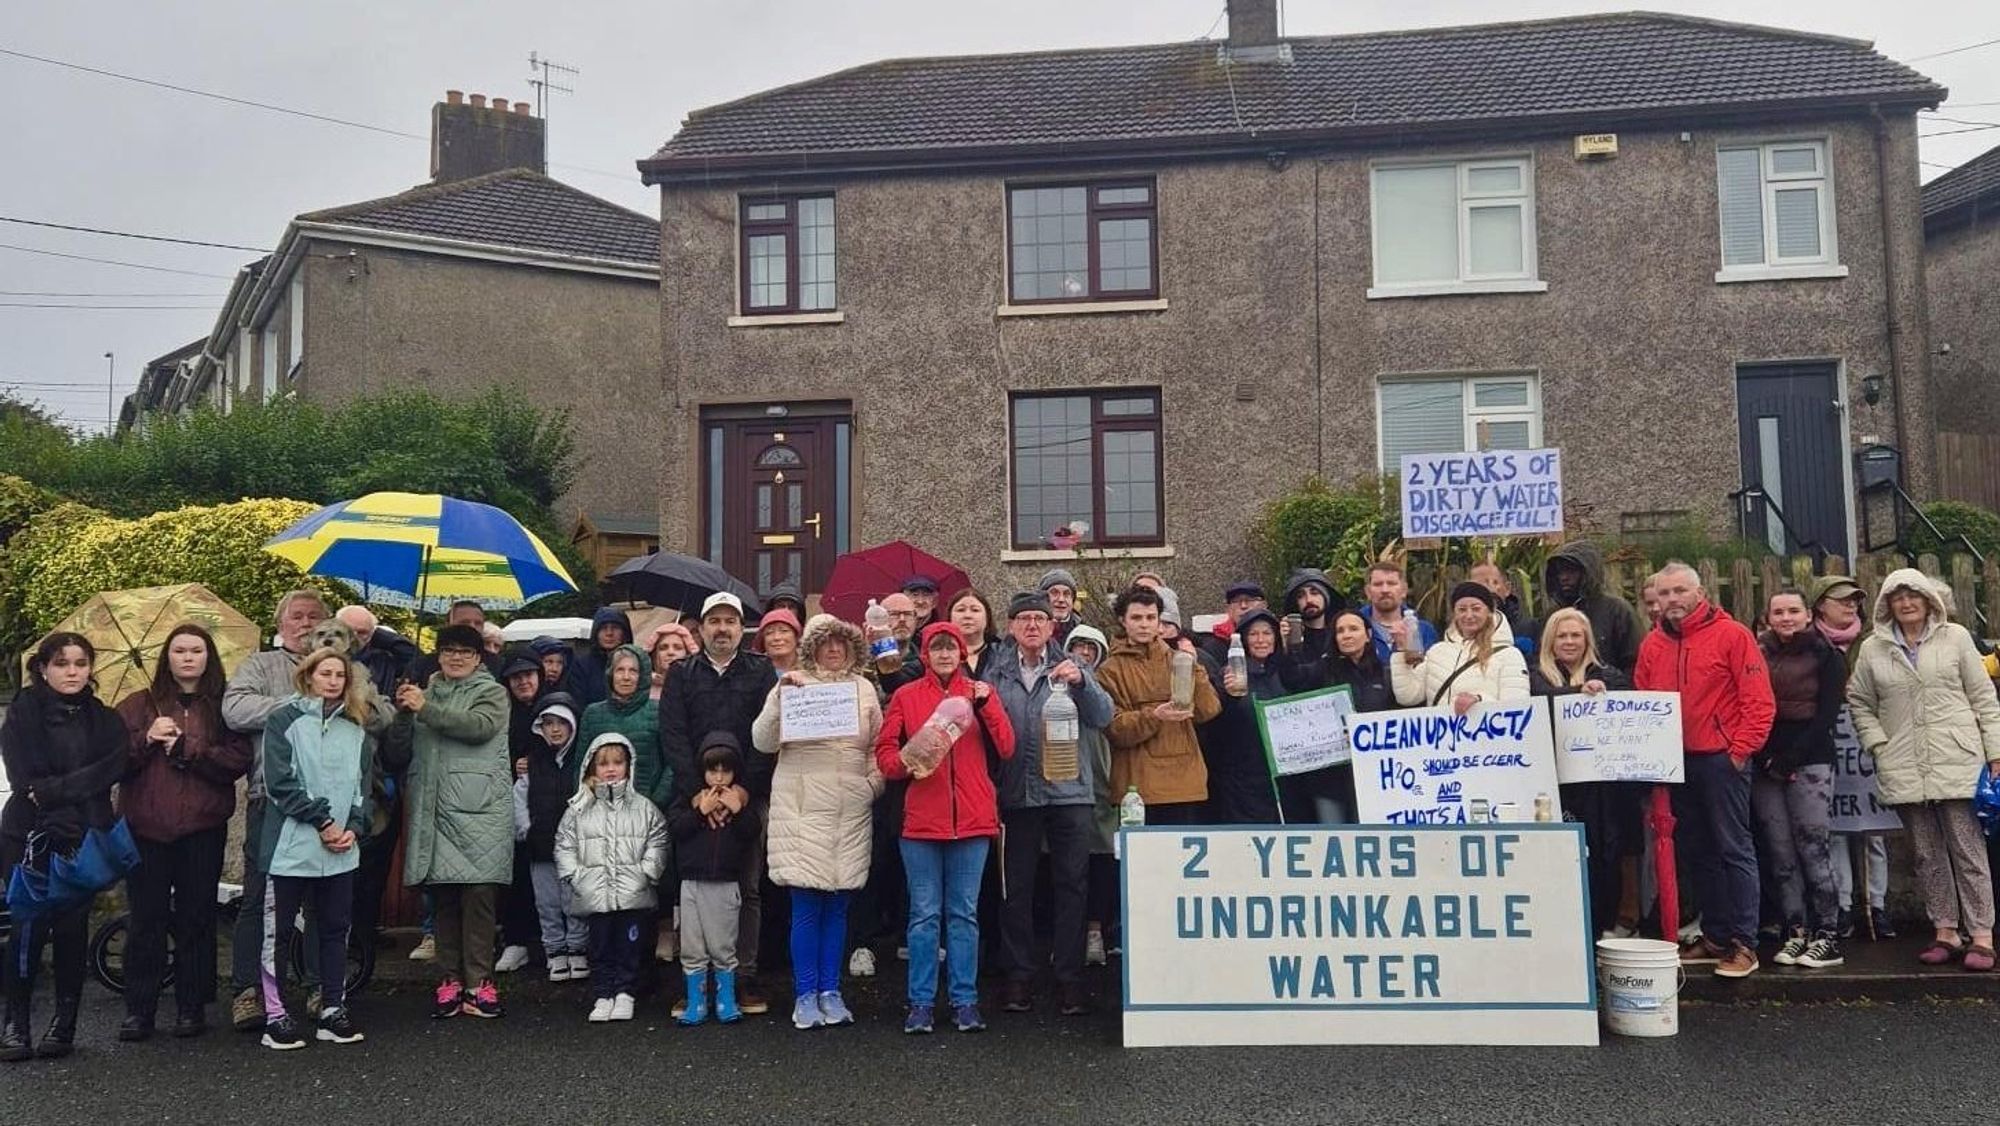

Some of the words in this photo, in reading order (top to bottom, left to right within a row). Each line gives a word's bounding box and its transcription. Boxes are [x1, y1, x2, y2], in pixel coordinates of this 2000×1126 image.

[1409, 463, 1424, 485] 2
[1429, 455, 1517, 486] YEARS
[1529, 454, 1557, 475] OF
[1409, 487, 1488, 512] DIRTY
[1494, 481, 1560, 510] WATER
[1410, 509, 1556, 534] DISGRACEFUL!
[1605, 699, 1672, 716] BONUSES
[1353, 717, 1421, 751] CLEAN
[1426, 717, 1447, 749] UP
[1471, 705, 1533, 741] ACT!
[1462, 755, 1479, 768] BE
[1482, 754, 1532, 768] CLEAR
[1438, 781, 1462, 795] AND
[1182, 836, 1210, 878] 2
[1251, 836, 1416, 878] YEARS
[1460, 835, 1519, 877] OF
[1177, 895, 1532, 938] UNDRINKABLE
[1269, 955, 1441, 998] WATER
